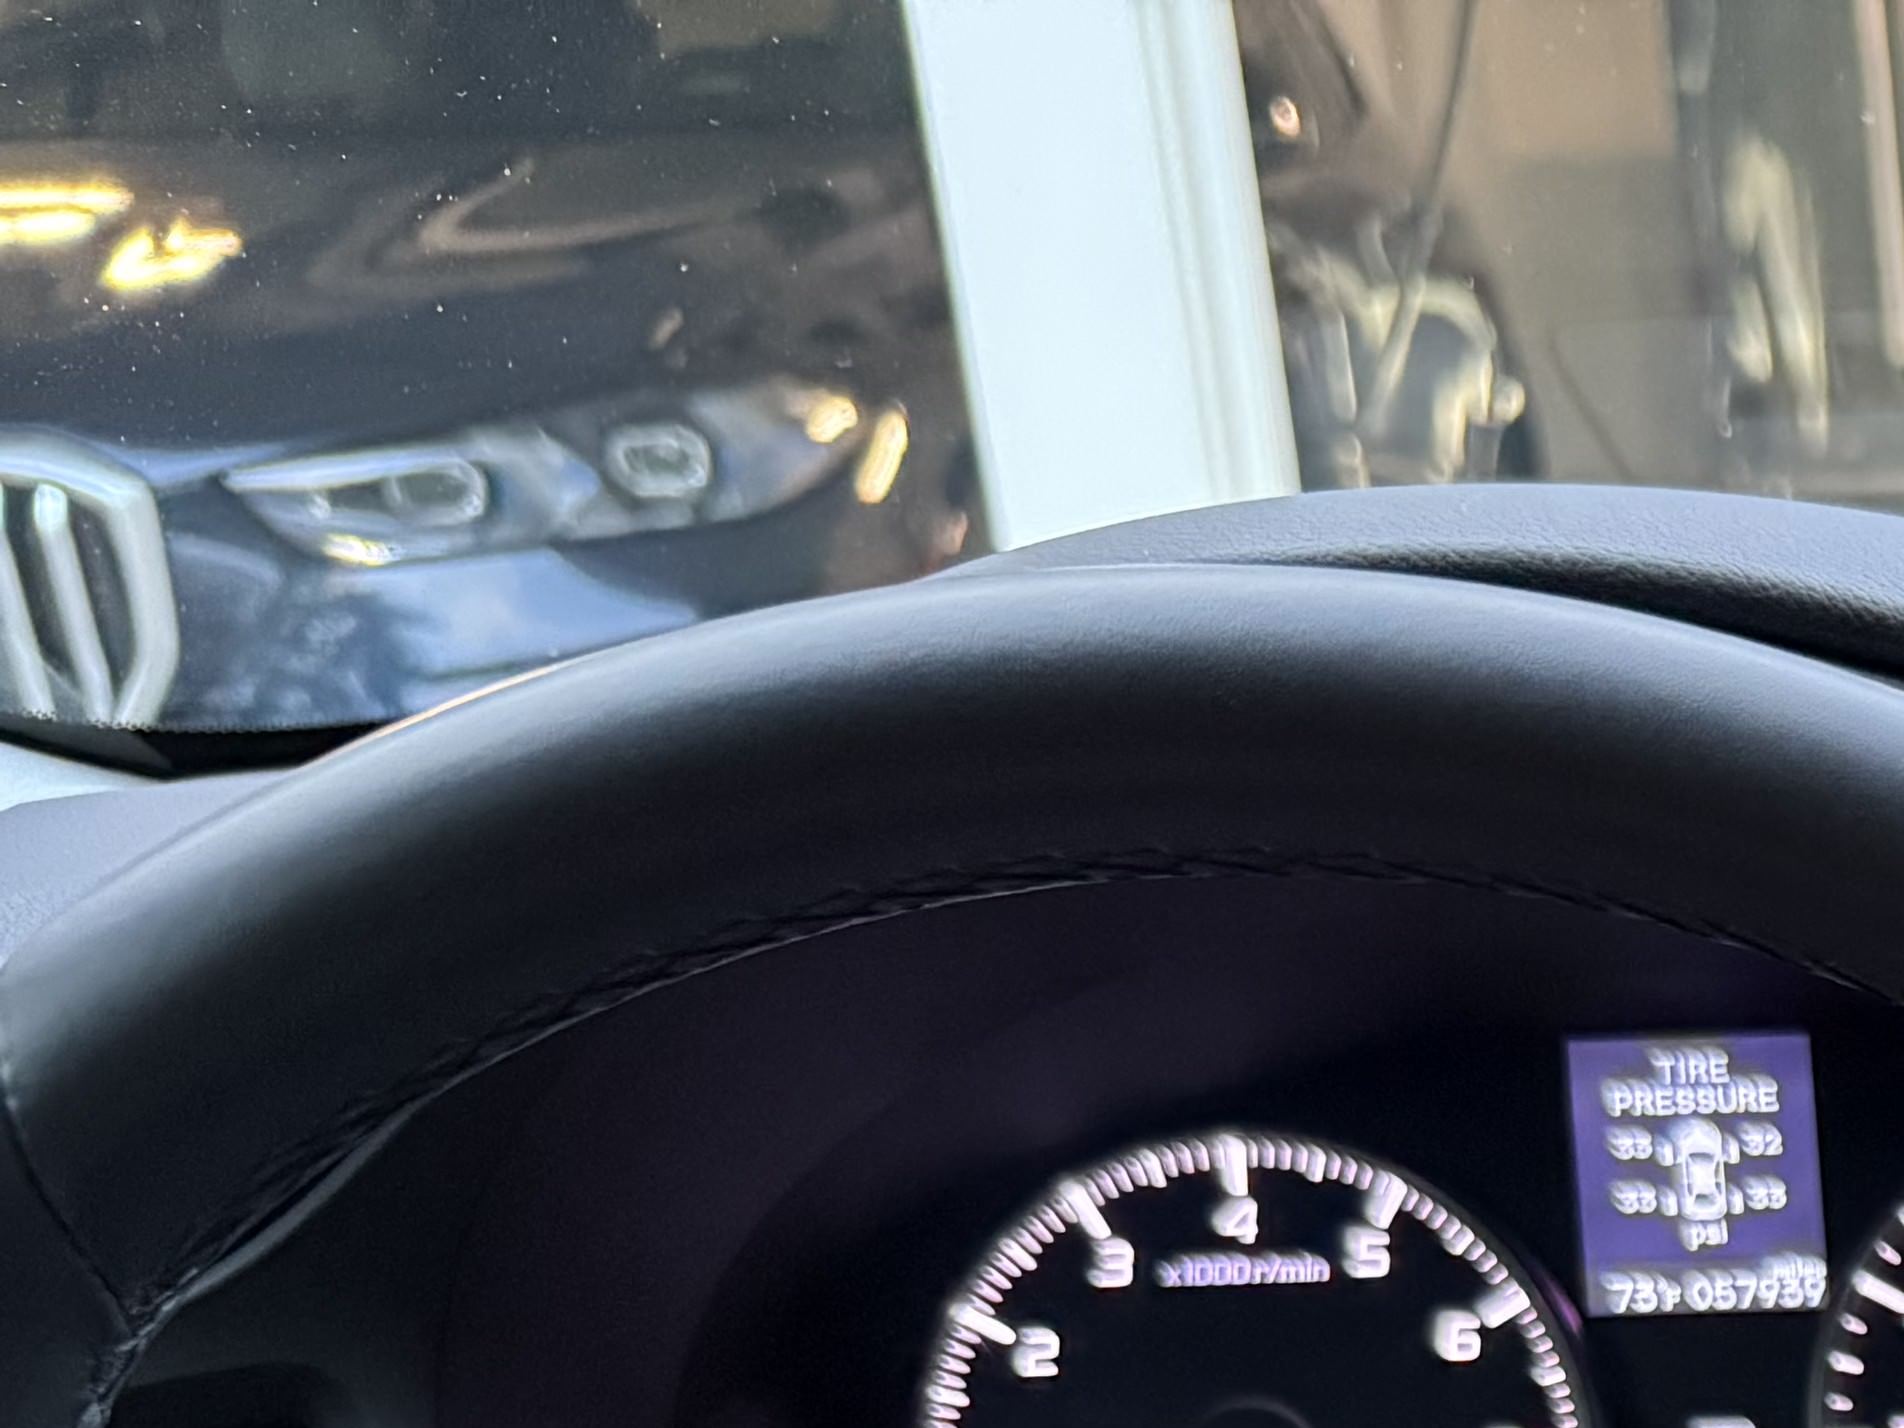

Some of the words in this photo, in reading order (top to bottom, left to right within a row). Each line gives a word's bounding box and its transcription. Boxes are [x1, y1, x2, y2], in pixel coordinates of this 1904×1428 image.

[1647, 1046, 1730, 1085] TIRE
[1601, 1074, 1781, 1117] PRESSURE
[1211, 1196, 1259, 1245] 4
[1679, 1217, 1729, 1252] psi
[1086, 1236, 1135, 1289] 3
[1341, 1221, 1392, 1279] 5
[1011, 1326, 1061, 1378] 2
[1432, 1309, 1483, 1362] 6
